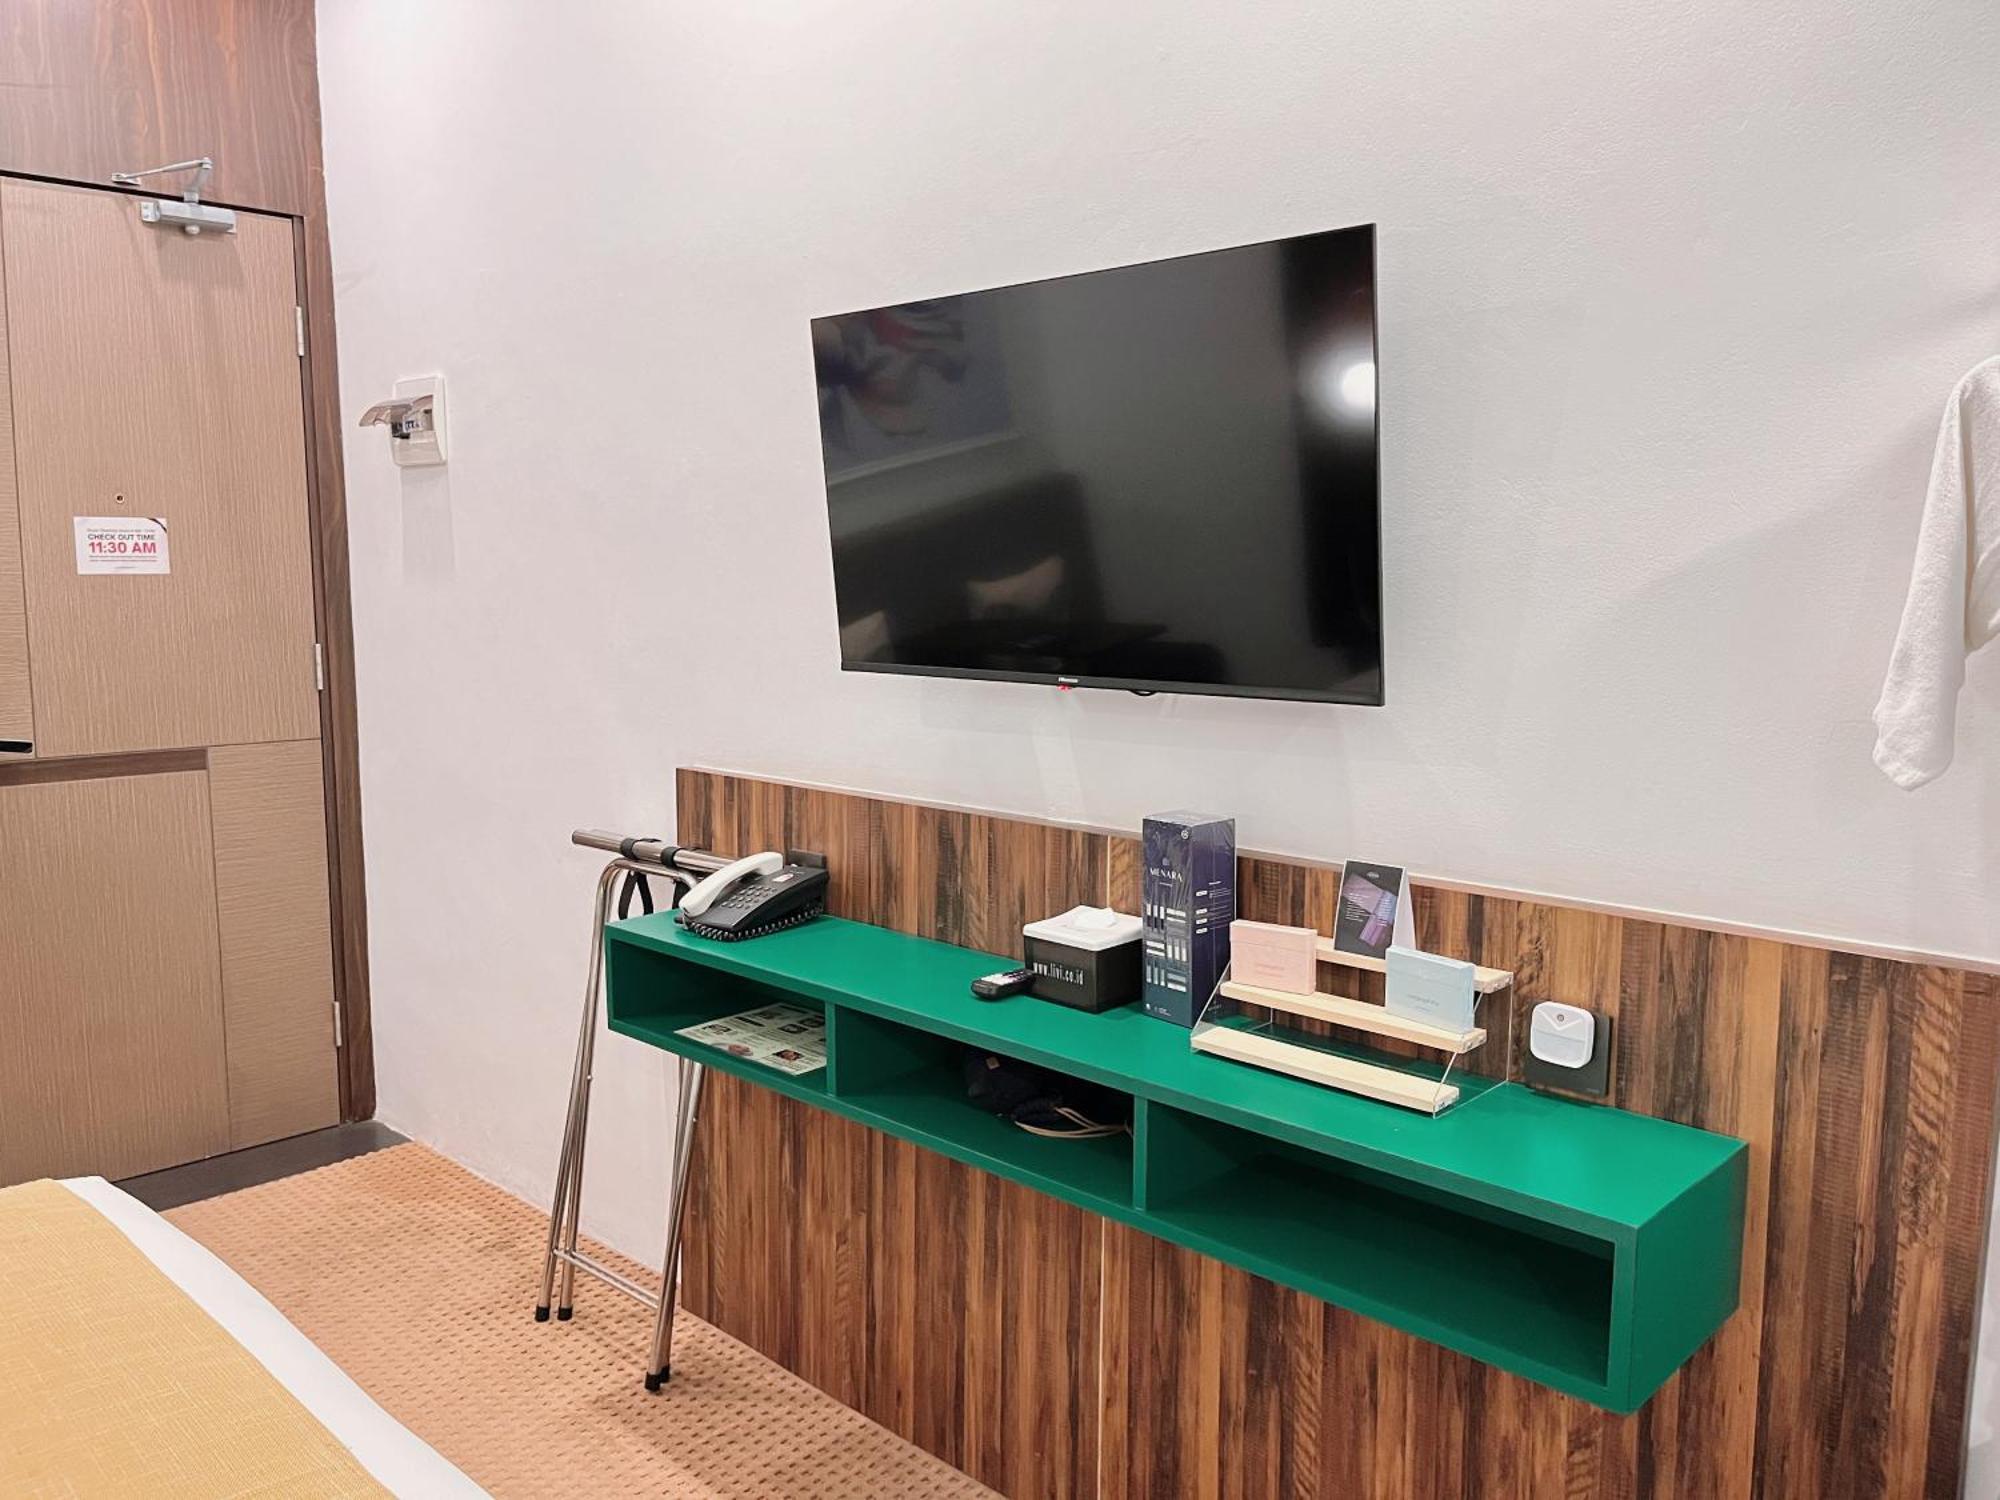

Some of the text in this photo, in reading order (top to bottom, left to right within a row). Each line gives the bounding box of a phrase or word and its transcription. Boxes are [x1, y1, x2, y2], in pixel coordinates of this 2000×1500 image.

[87, 533, 155, 541] CHECK OUT TIME
[88, 541, 157, 554] 11:30 AM
